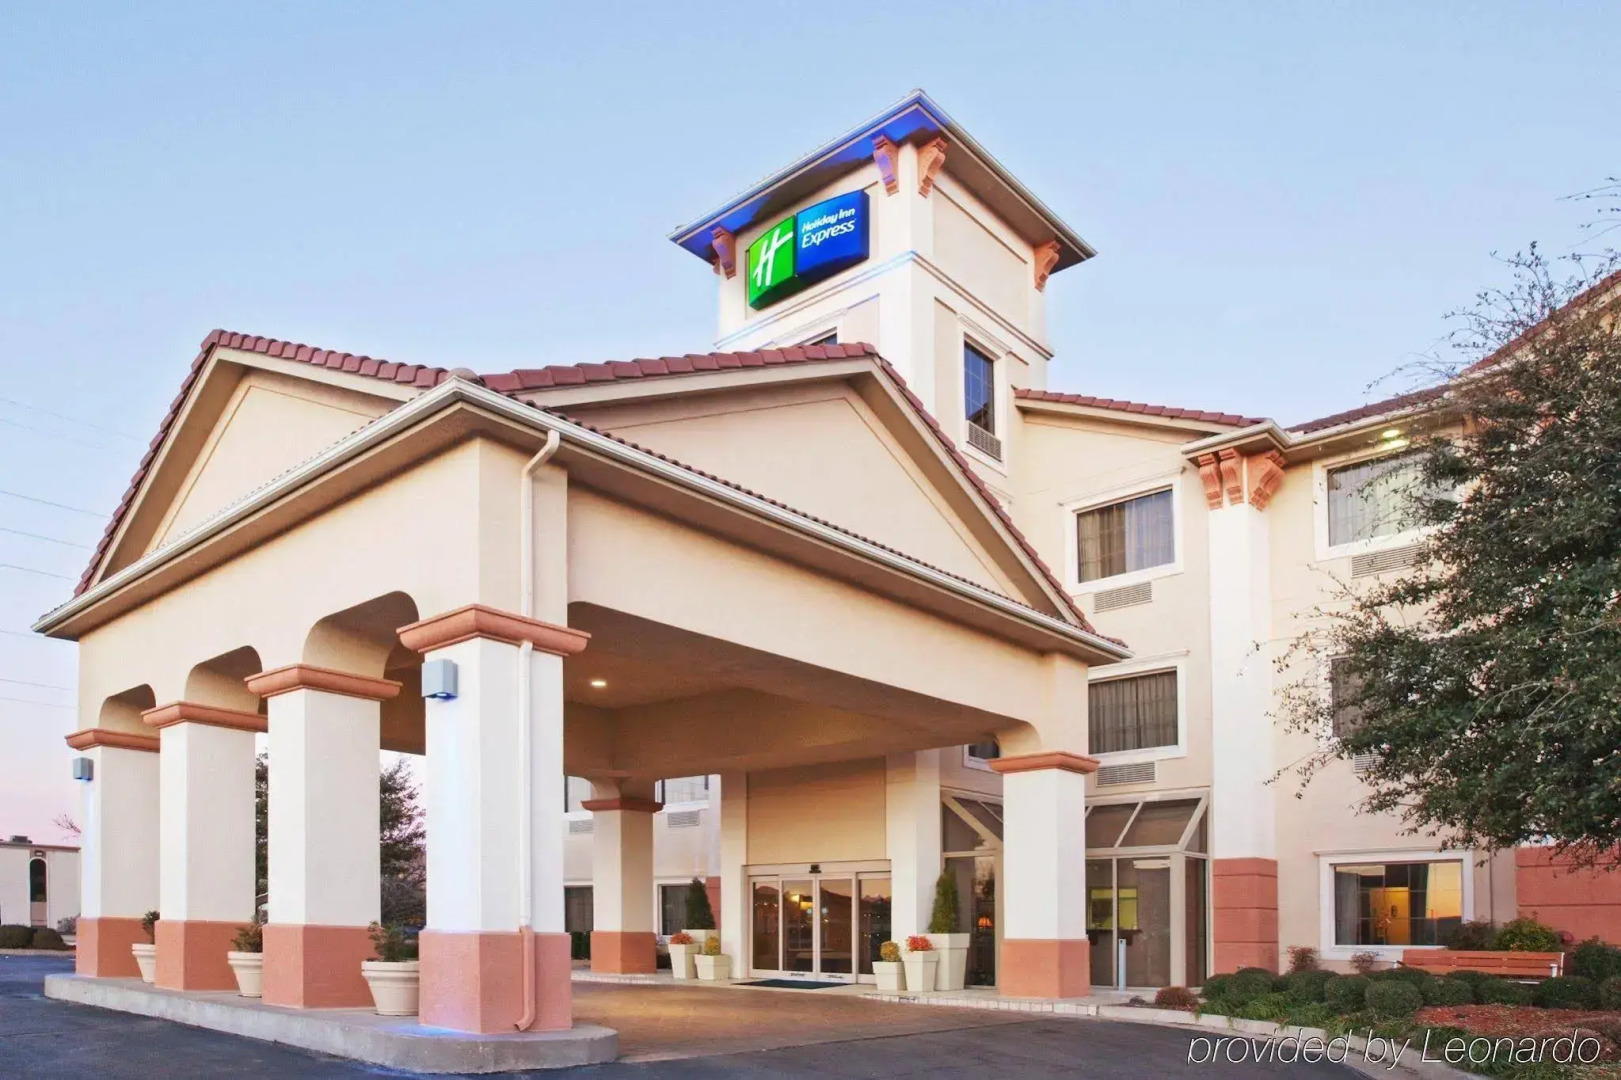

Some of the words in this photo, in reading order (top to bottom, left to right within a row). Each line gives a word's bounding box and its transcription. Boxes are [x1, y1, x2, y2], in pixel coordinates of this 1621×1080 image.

[802, 213, 838, 233] Holiday
[839, 208, 856, 220] Inn
[802, 220, 856, 248] Express
